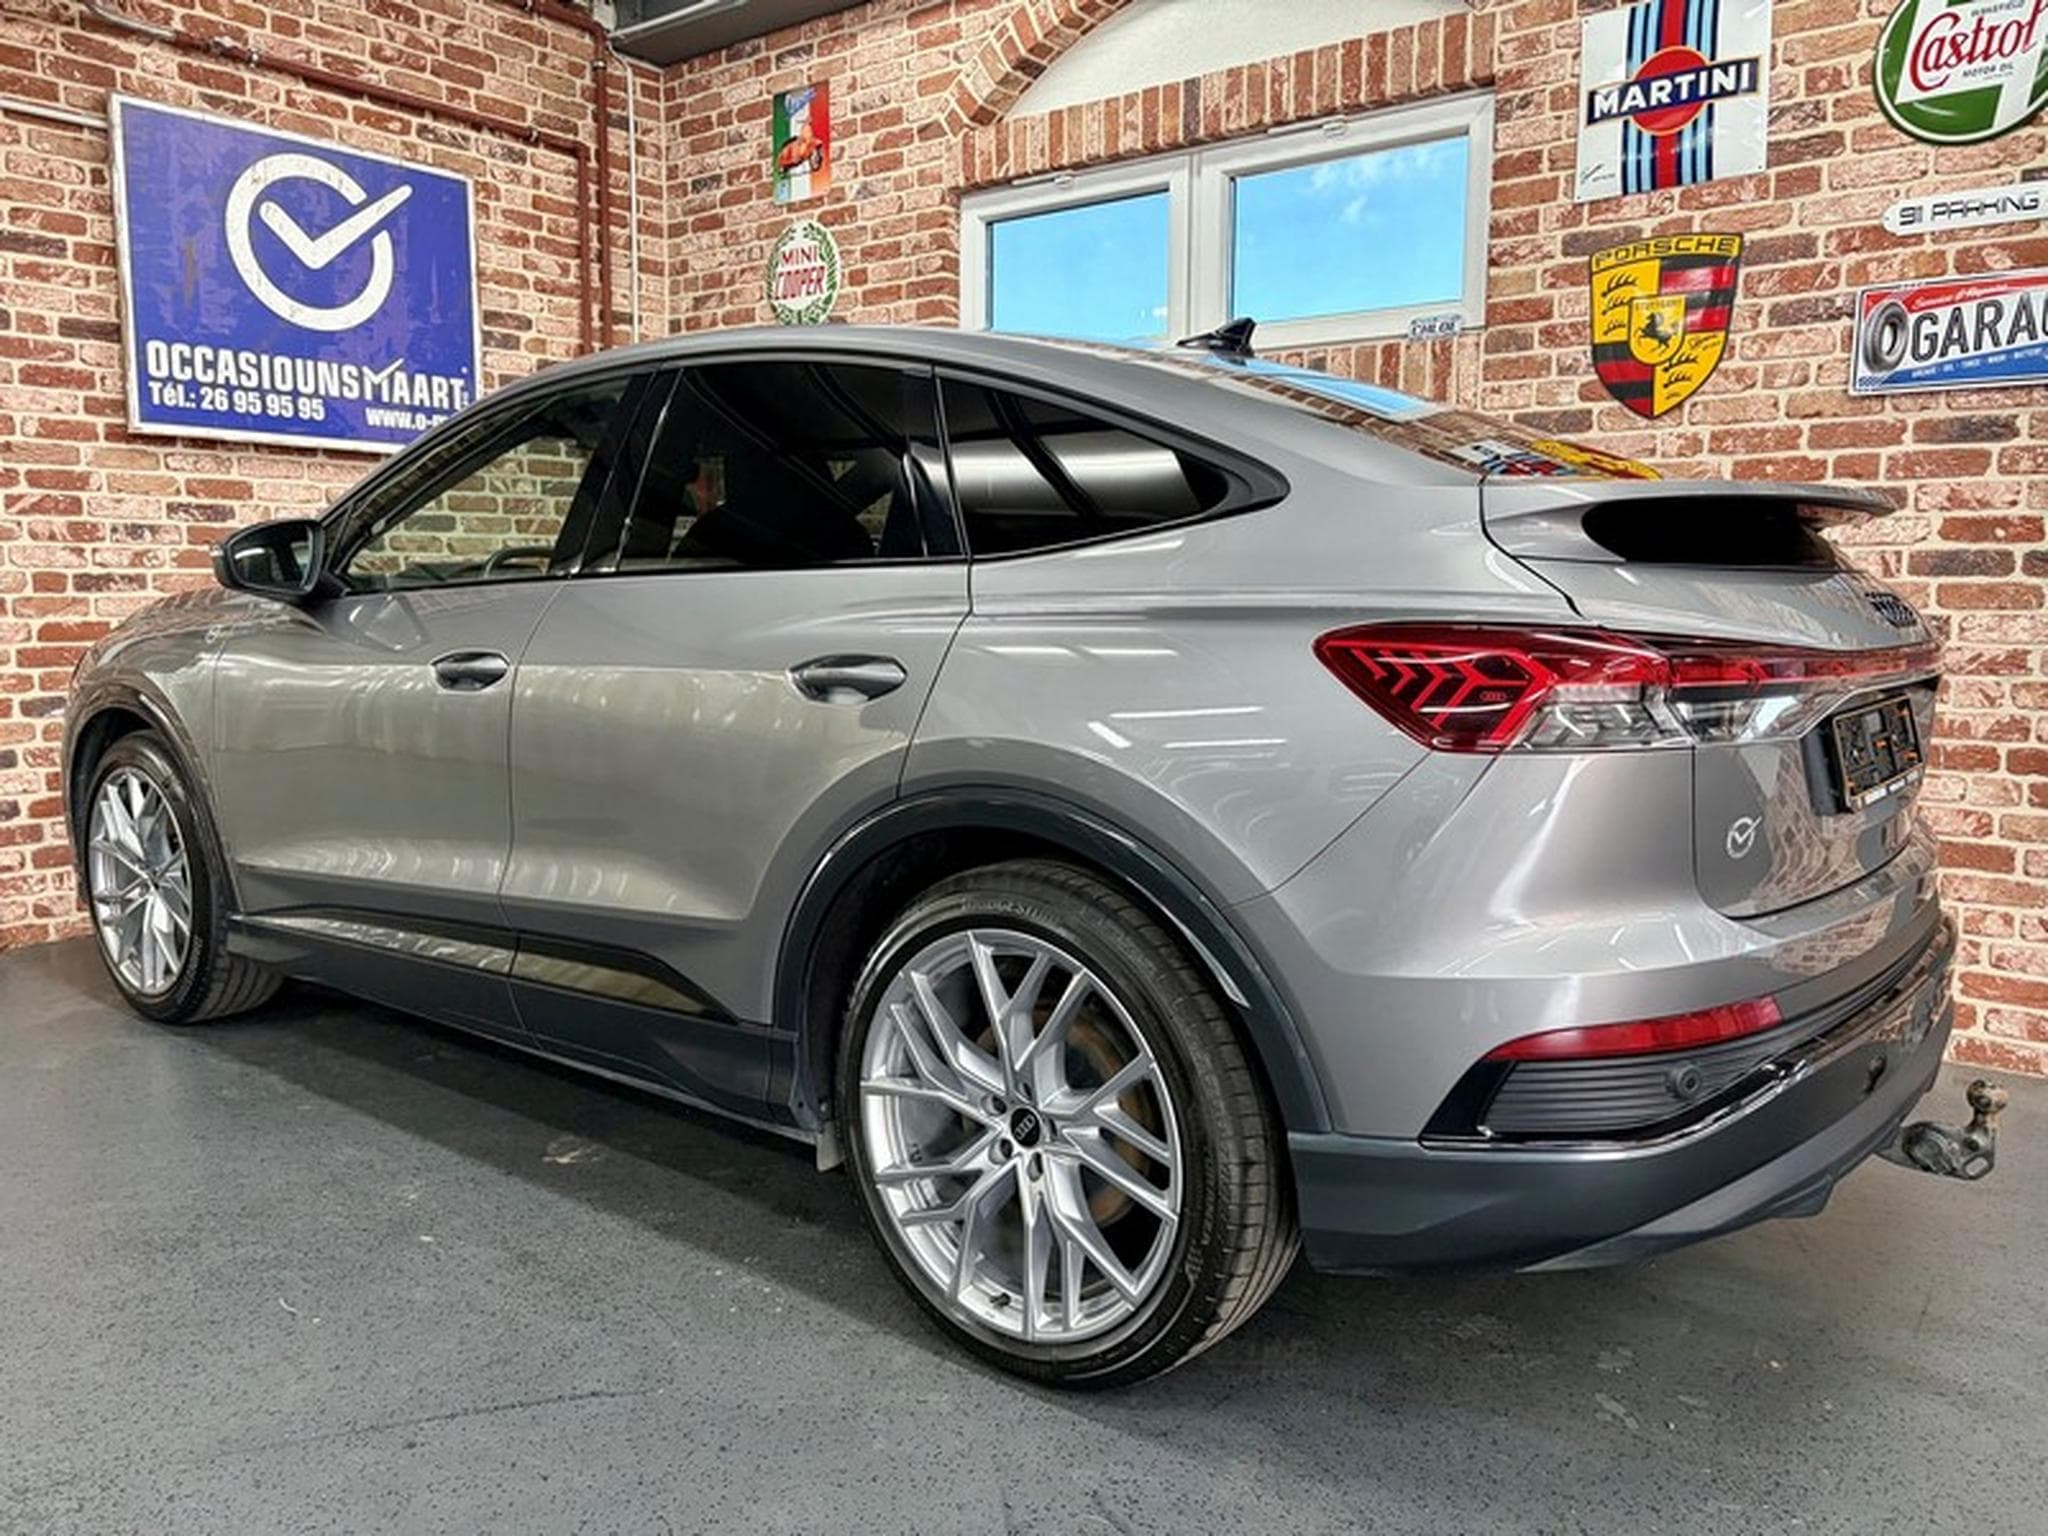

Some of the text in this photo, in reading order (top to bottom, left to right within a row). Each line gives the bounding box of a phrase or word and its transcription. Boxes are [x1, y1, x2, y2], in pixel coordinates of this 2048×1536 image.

[1909, 0, 2048, 92] Castrol
[1593, 62, 1750, 119] MARTINI
[1930, 191, 2039, 221] PARKING
[781, 244, 819, 268] MINI
[1595, 237, 1737, 269] PORSCHE
[774, 265, 826, 300] COOPER
[200, 386, 229, 411] 26
[233, 390, 262, 415] 95
[266, 393, 294, 418] 95
[298, 396, 326, 421] 95
